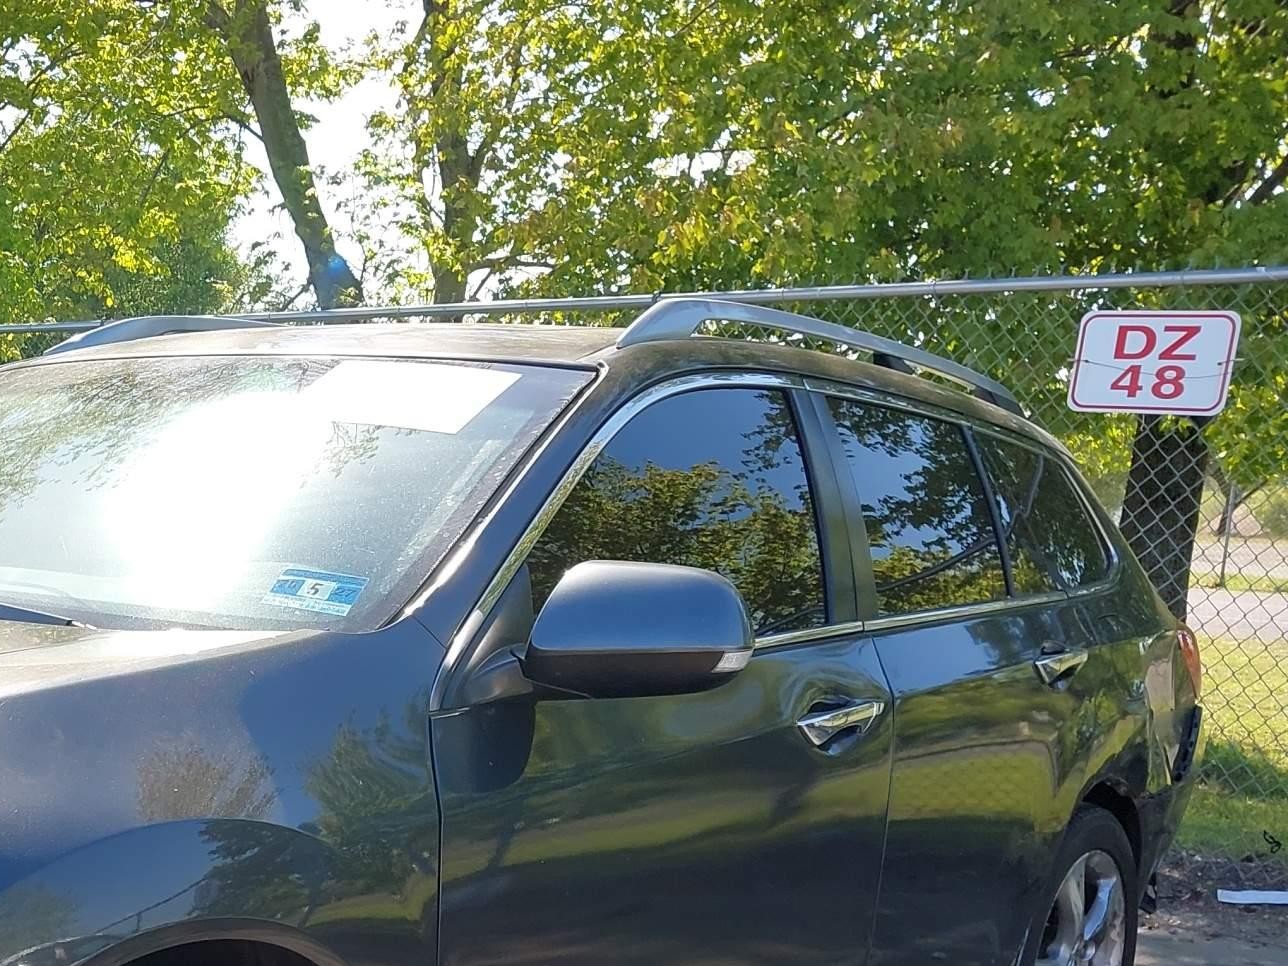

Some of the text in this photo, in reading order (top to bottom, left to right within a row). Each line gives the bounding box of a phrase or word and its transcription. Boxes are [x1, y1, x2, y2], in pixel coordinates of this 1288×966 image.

[1113, 325, 1202, 361] DZ
[1110, 365, 1186, 400] 48
[306, 582, 324, 596] 5
